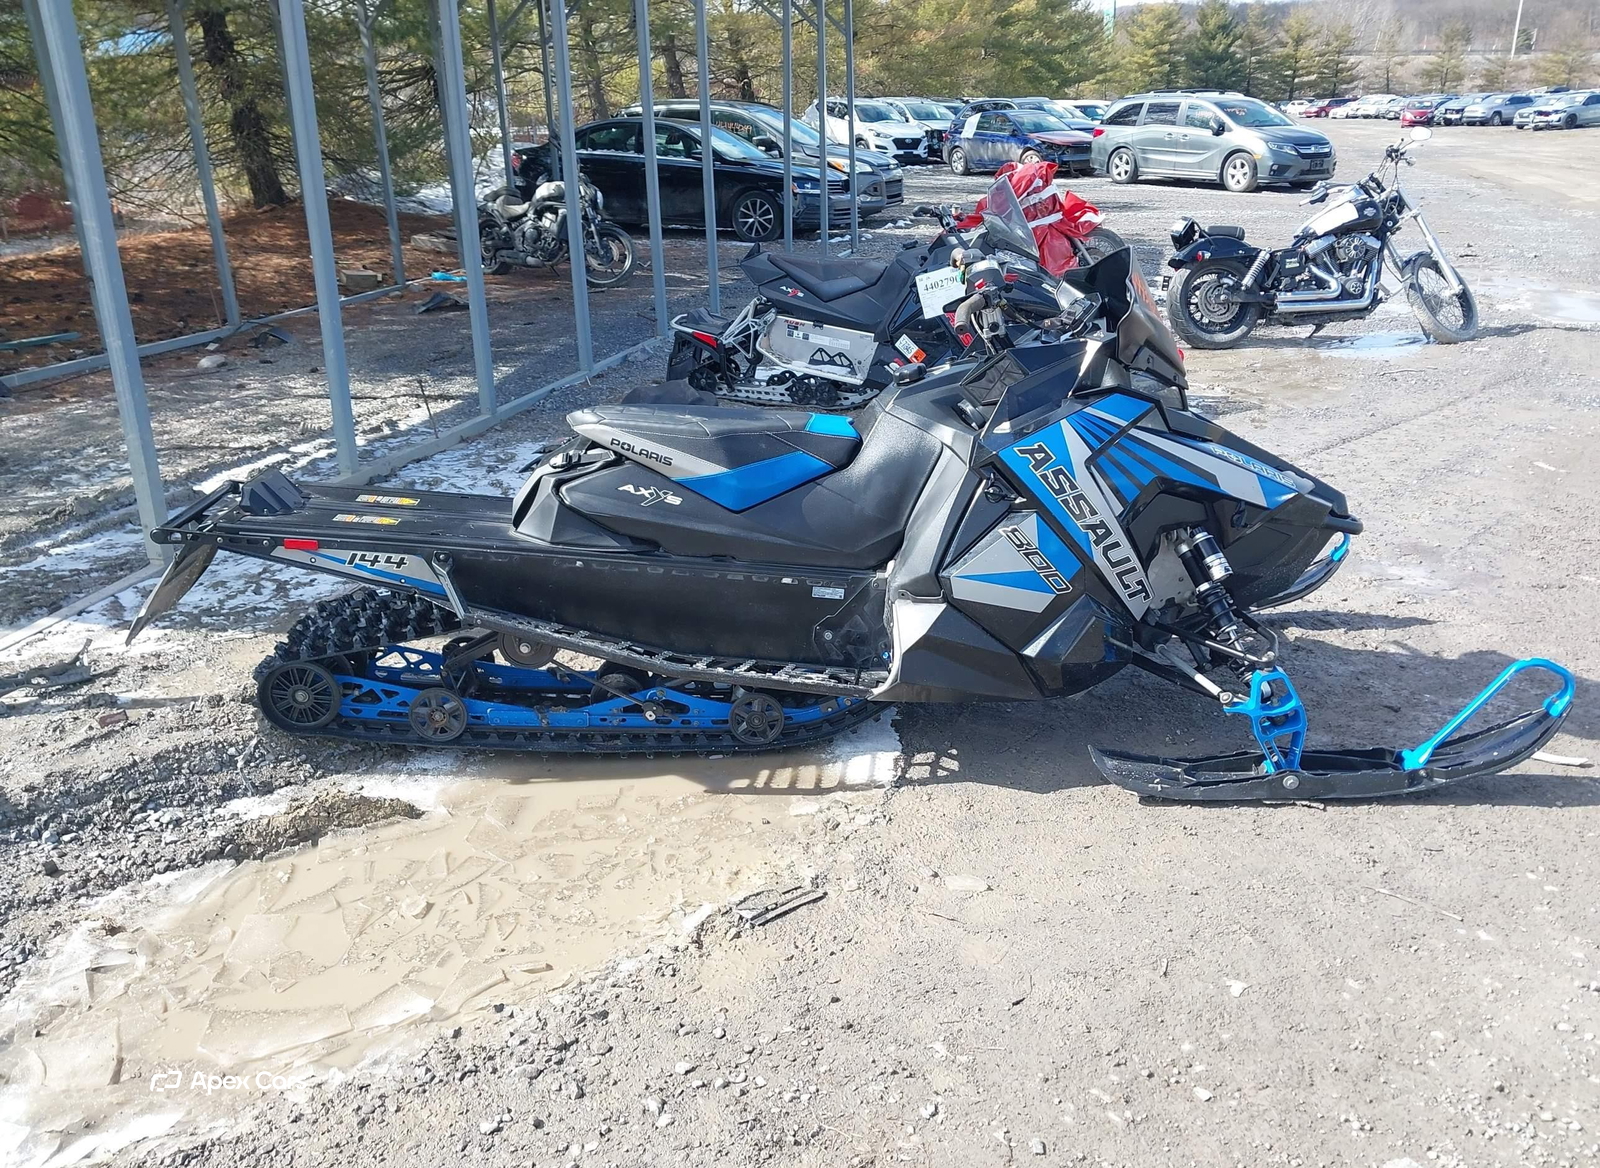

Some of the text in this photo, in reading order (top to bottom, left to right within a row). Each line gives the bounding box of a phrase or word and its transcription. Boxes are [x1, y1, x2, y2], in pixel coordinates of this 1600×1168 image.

[610, 438, 673, 466] POLARIS
[617, 484, 683, 507] AXYS
[1013, 442, 1153, 602] ASSAULT
[346, 551, 409, 570] 144
[998, 525, 1073, 594] 800
